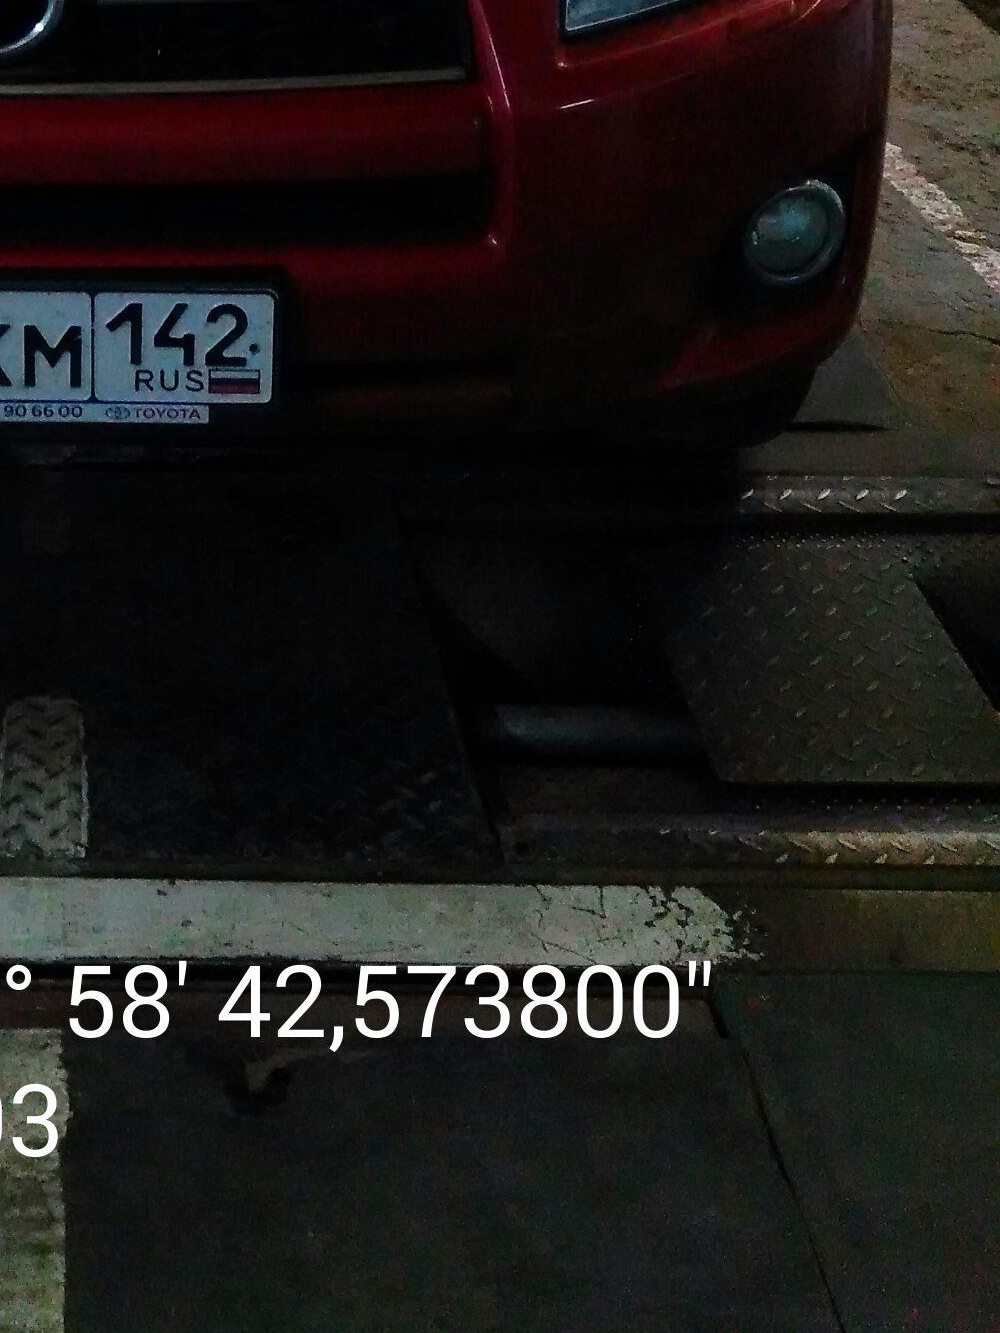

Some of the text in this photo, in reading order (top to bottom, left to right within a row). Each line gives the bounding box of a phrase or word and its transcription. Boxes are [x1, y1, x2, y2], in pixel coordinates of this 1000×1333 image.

[105, 302, 249, 368] 142
[135, 369, 204, 393] RUS
[4, 405, 26, 417] 90
[32, 405, 54, 417] 66
[58, 405, 82, 417] 00
[135, 407, 201, 419] TOYOTA
